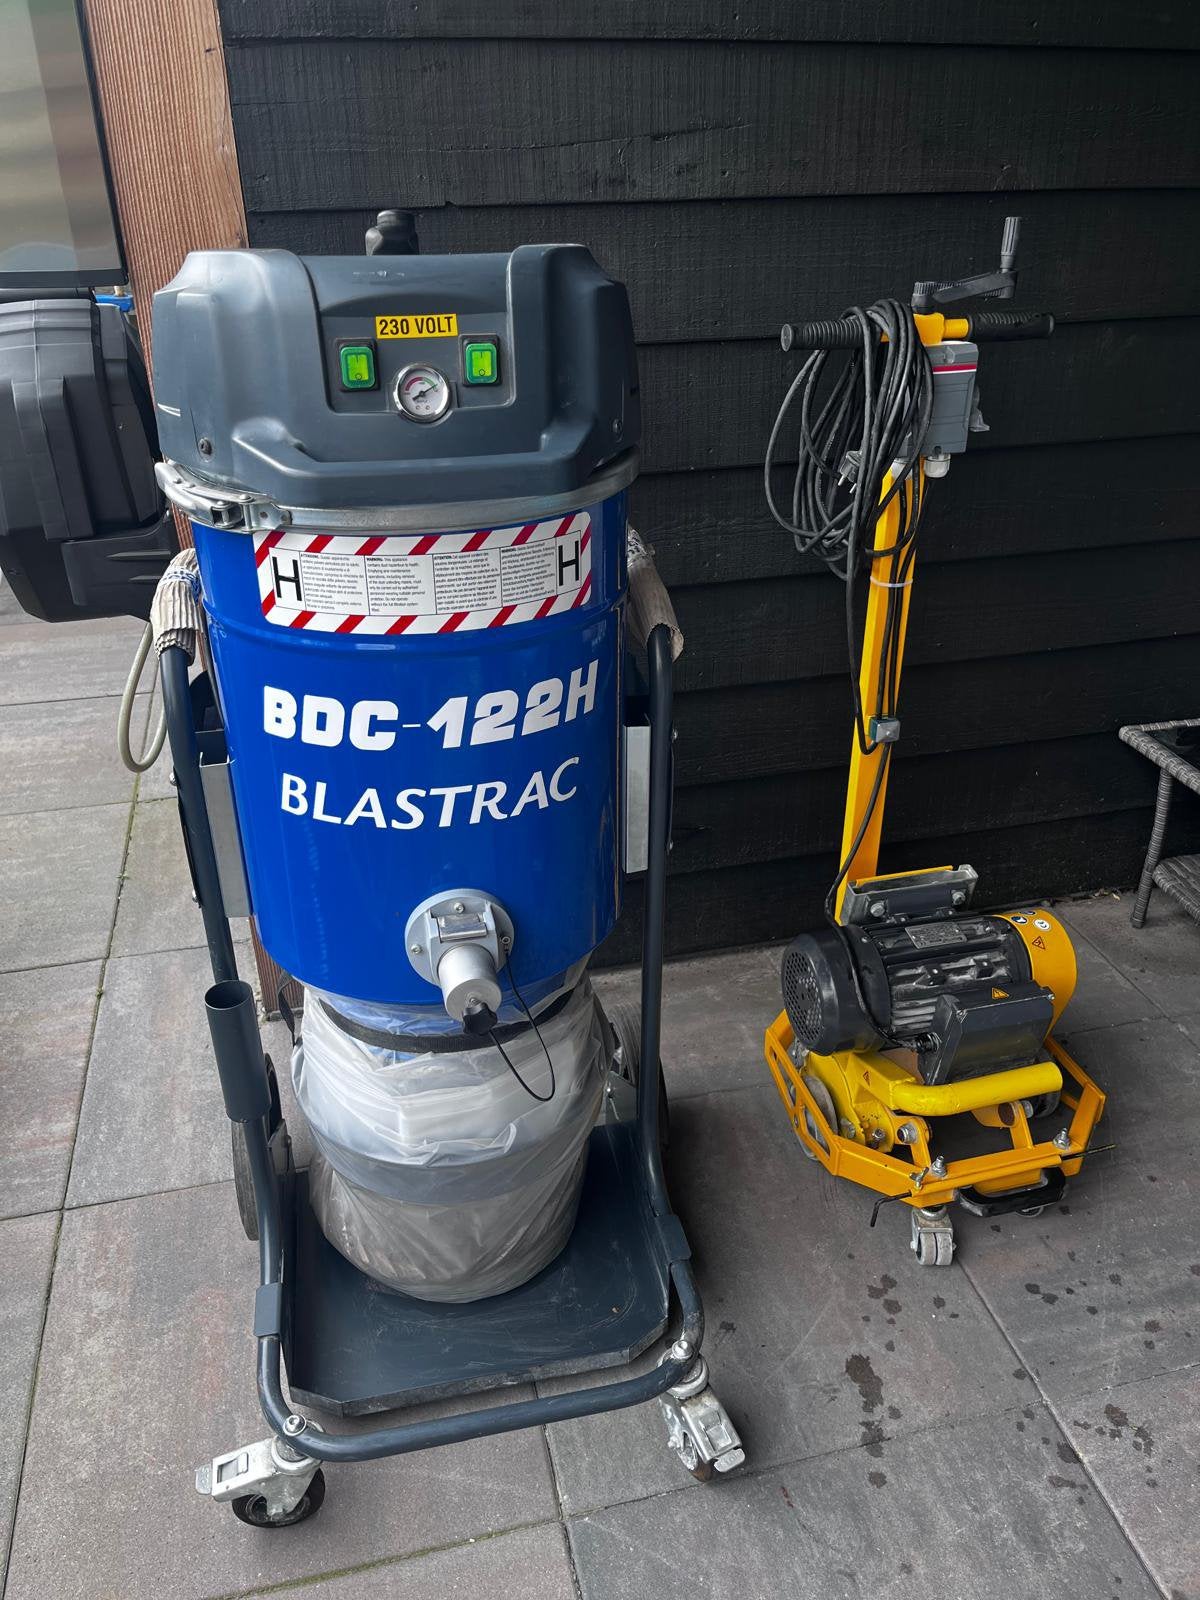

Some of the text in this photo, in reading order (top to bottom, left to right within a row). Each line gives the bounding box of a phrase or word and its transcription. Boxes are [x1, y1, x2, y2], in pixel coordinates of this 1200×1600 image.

[379, 316, 453, 336] 230 VOLT
[272, 556, 302, 602] H
[557, 540, 580, 587] H
[264, 659, 599, 751] BDC-122H
[281, 757, 579, 830] BLASTRAC
